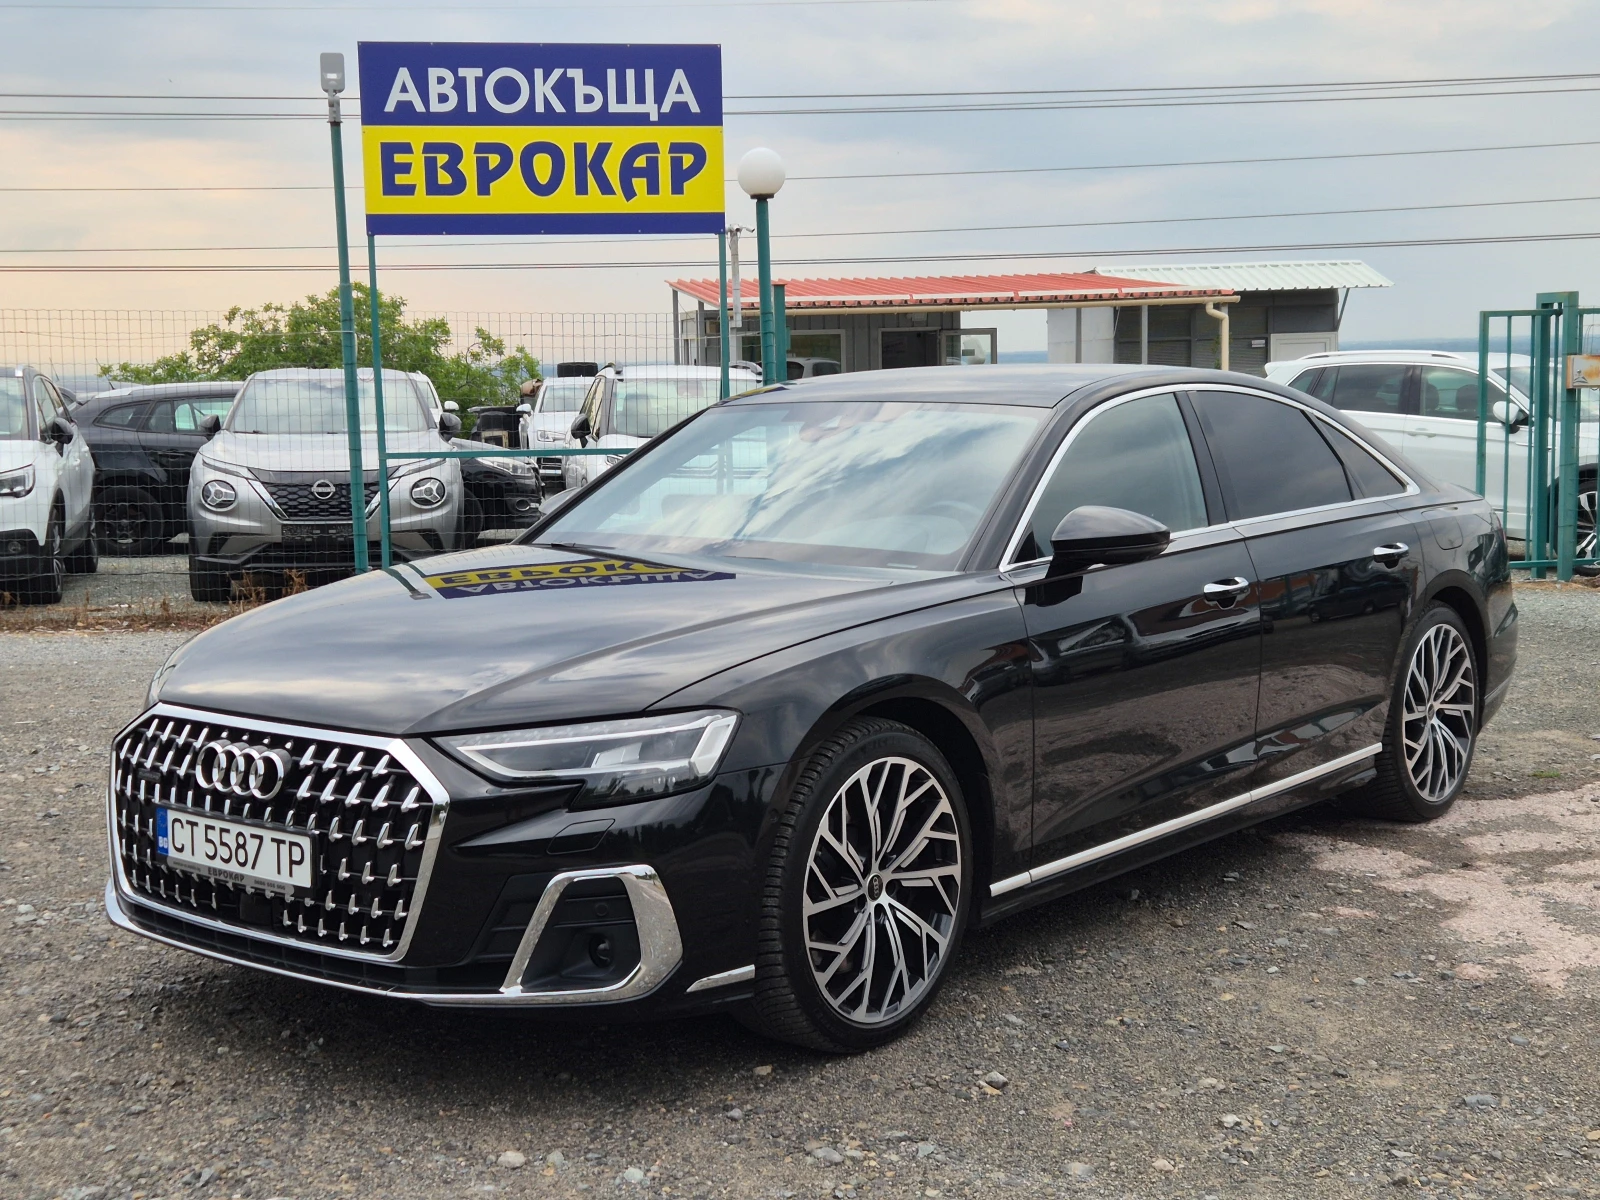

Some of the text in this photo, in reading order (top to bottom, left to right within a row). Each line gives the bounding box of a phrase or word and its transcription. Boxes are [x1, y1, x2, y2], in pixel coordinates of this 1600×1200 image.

[383, 67, 701, 121] АВТОКЪЩА
[379, 141, 708, 203] ЕВРОКАР
[171, 818, 305, 878] CT 5587 TP
